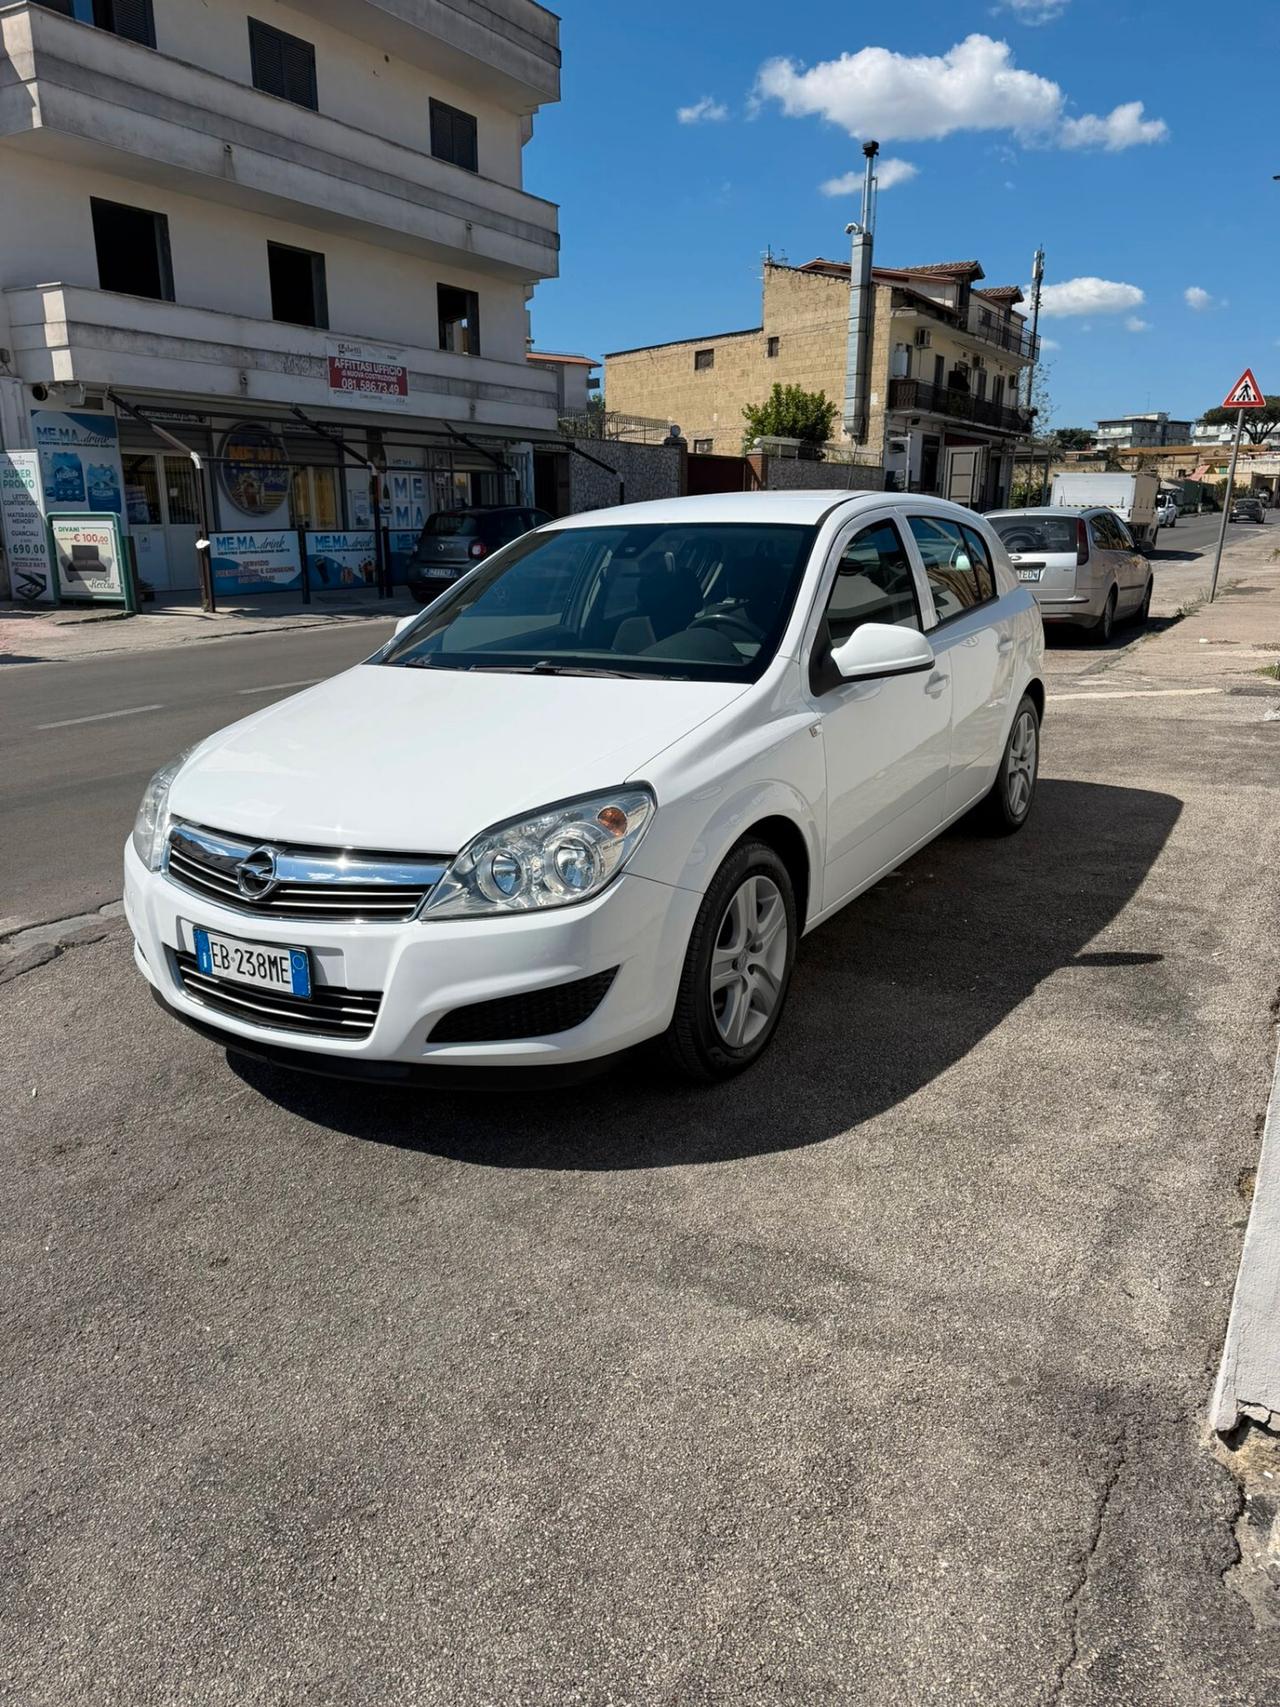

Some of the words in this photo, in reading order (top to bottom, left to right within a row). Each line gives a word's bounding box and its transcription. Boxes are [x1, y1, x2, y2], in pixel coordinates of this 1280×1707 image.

[335, 359, 373, 372] AFFITTASI
[374, 362, 403, 377] UFFICIO
[3, 469, 31, 478] SUPER
[3, 479, 35, 489] PROMO
